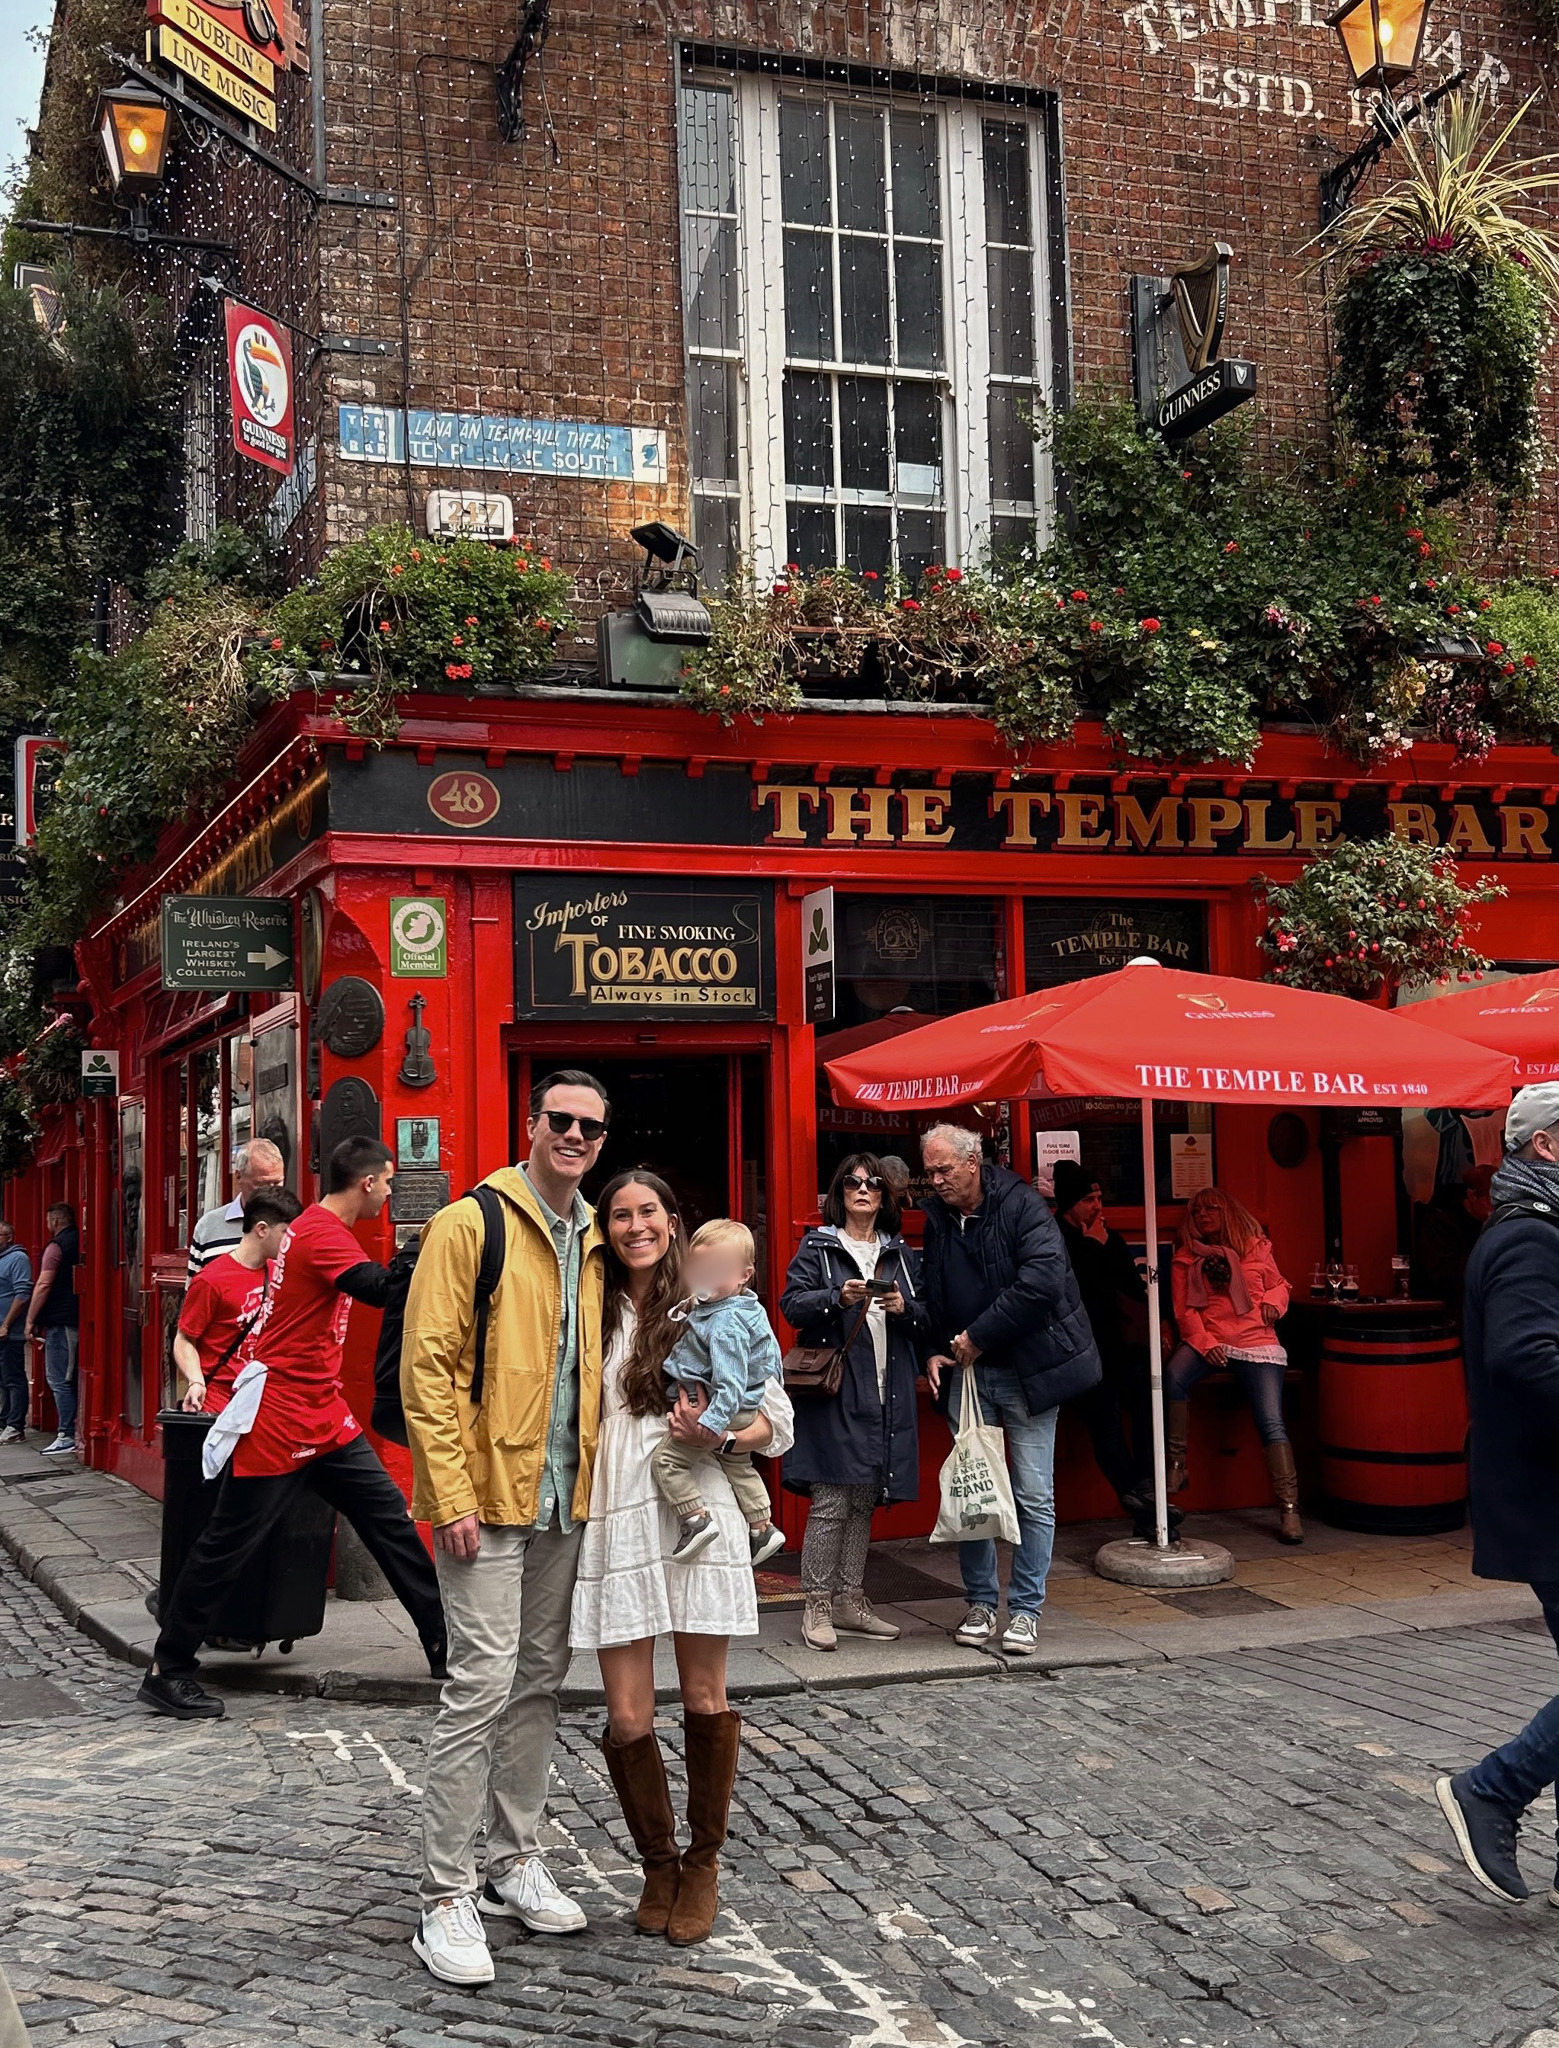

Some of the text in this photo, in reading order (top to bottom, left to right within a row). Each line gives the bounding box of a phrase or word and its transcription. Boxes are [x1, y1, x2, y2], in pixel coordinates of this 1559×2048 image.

[185, 5, 254, 73] DUBLIN
[172, 38, 268, 120] LIVE MUSIC
[1159, 370, 1221, 427] GUINNESS
[242, 418, 287, 451] GUINNESS
[460, 421, 482, 440] AN
[551, 451, 618, 473] SOUTH
[439, 778, 485, 814] 48
[753, 784, 1552, 858] THE TEMPLE BAR
[171, 911, 187, 924] The
[241, 909, 288, 931] Reserve
[525, 890, 629, 933] Importers
[590, 914, 609, 927] OF
[1110, 913, 1134, 926] The
[618, 924, 737, 941] FINE SMOKING
[182, 939, 240, 949] IRELAND'S
[186, 949, 235, 958] LARGEST
[1051, 931, 1189, 960] TEMPLE BAR
[185, 959, 237, 968] WHISKEY
[401, 961, 438, 969] Member
[403, 952, 435, 961] Official
[554, 932, 738, 997] TOBACCO
[176, 968, 246, 978] COLLECTION
[594, 986, 754, 1003] Always in Stock
[1185, 1010, 1276, 1019] GUINNESS
[1527, 1063, 1547, 1075] EST
[854, 1083, 886, 1100] THE
[886, 1076, 935, 1100] TEMPLE
[935, 1074, 959, 1097] BAR
[1135, 1064, 1428, 1095] THE TEMPLE BAR EST 1840
